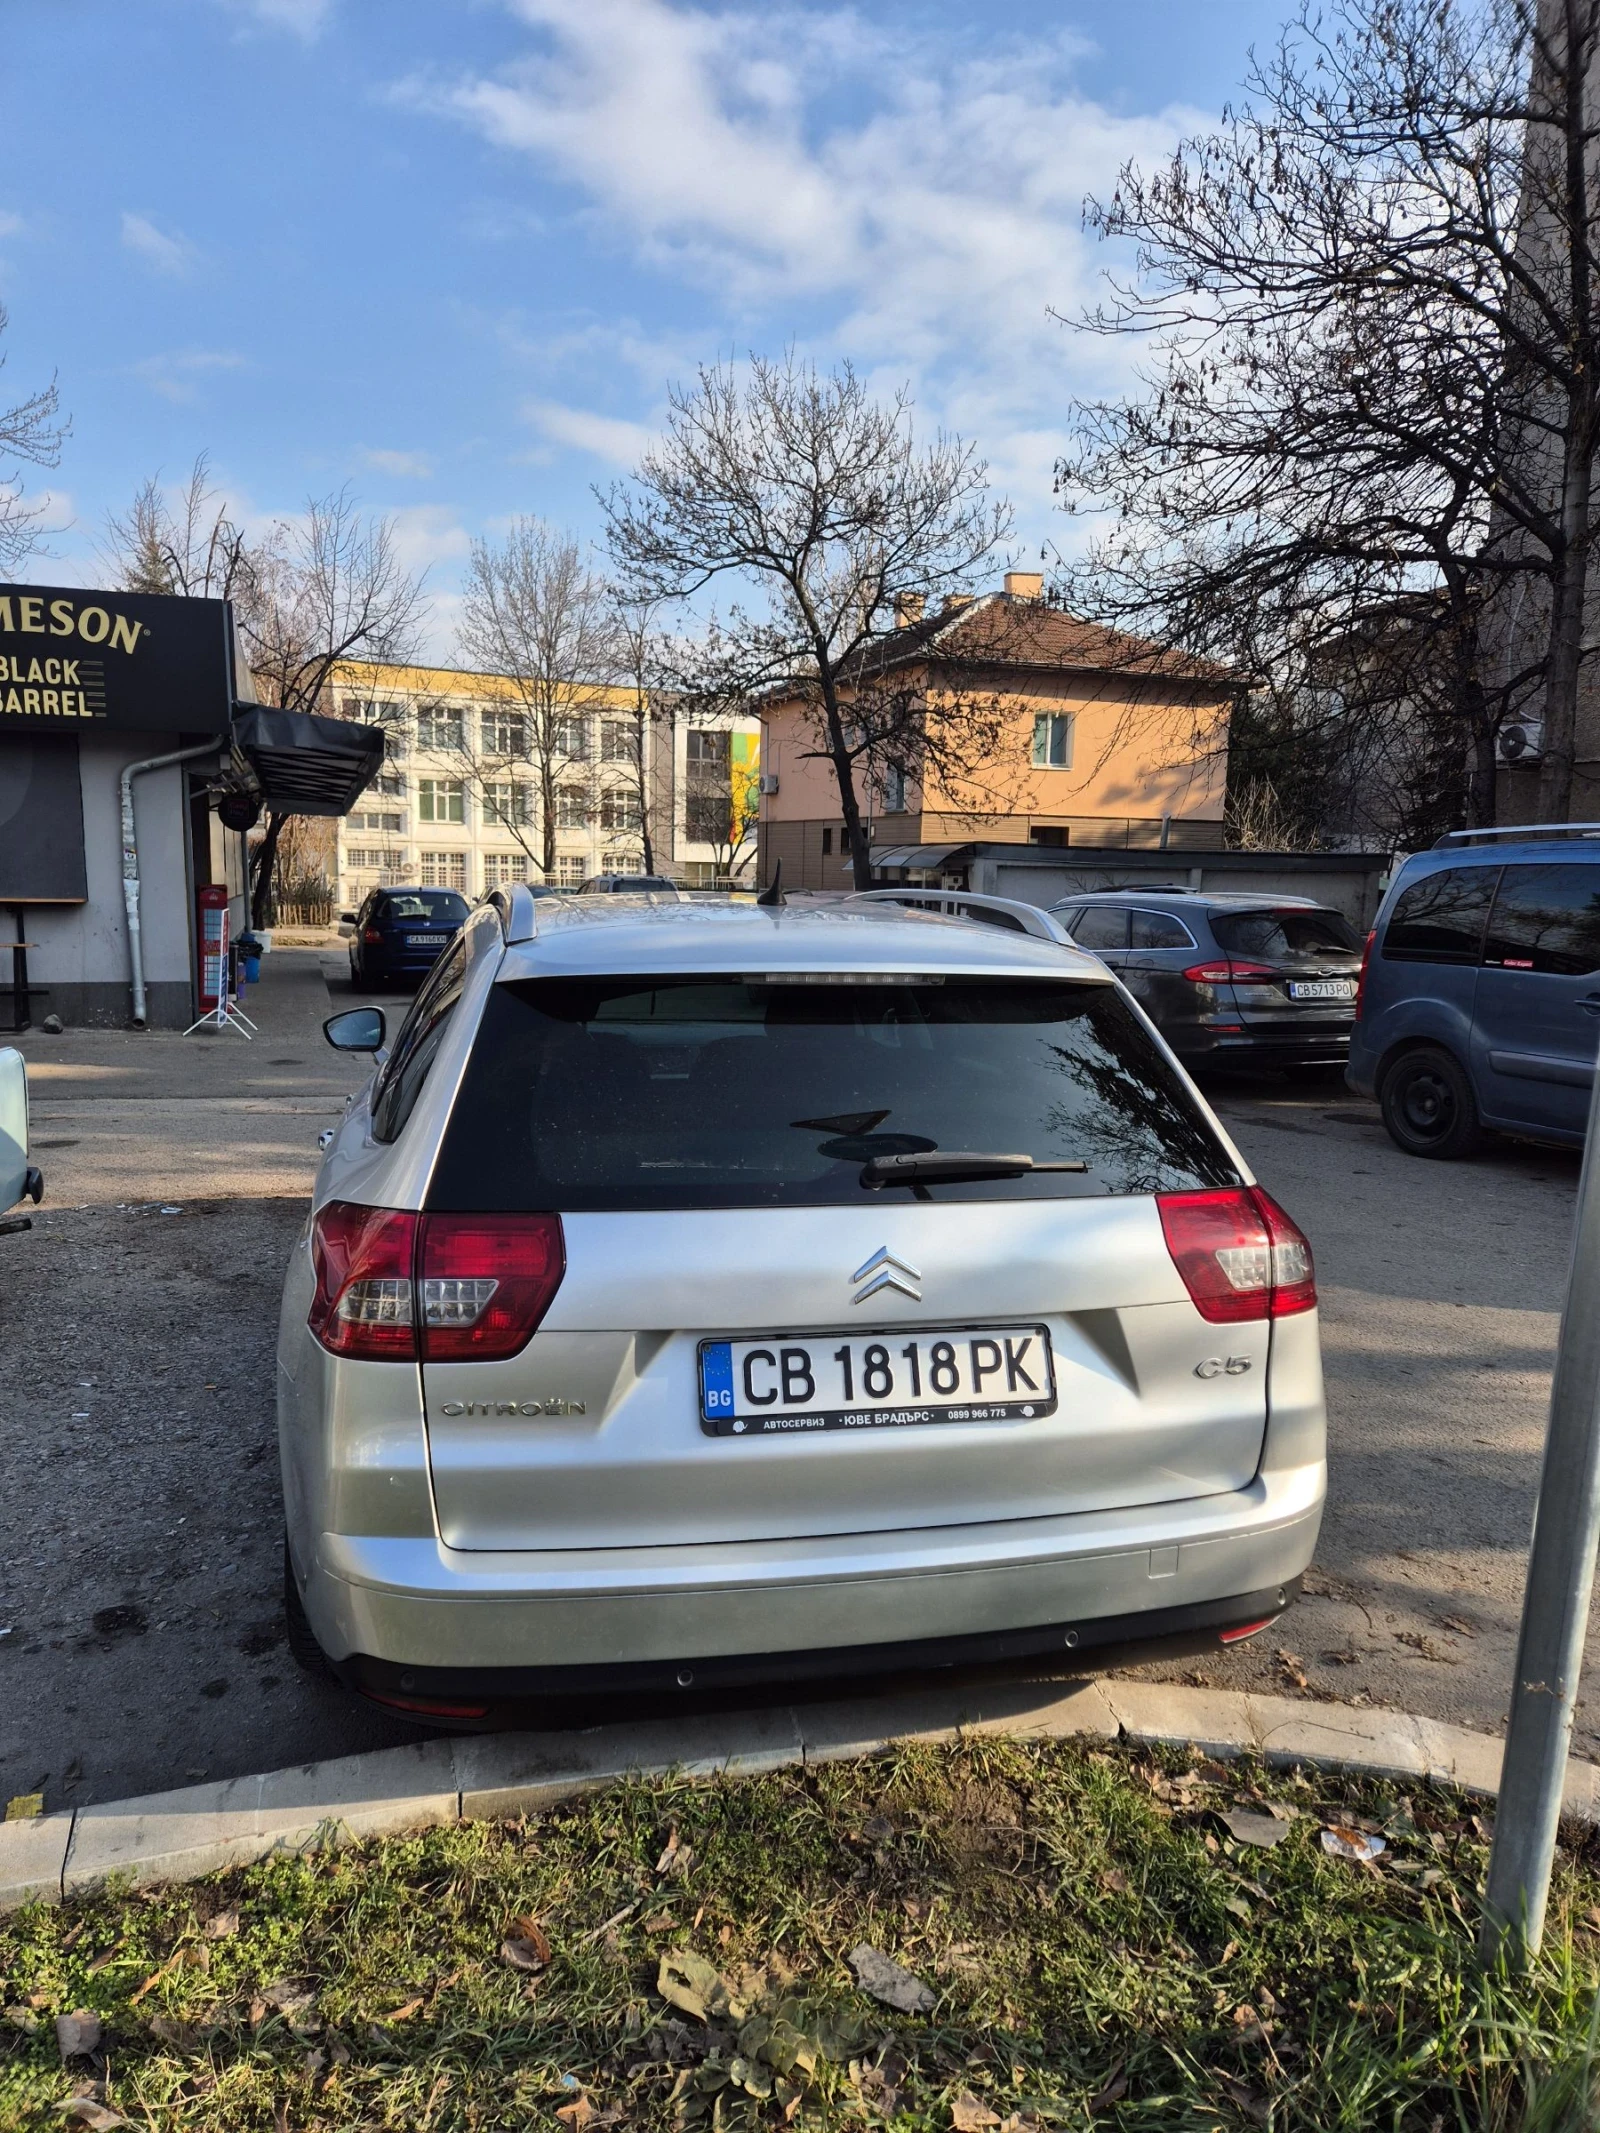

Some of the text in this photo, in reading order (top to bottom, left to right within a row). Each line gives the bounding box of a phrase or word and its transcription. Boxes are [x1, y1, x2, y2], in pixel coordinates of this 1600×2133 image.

[0, 687, 93, 717] ARREL
[1193, 1354, 1252, 1379] C5
[441, 1398, 587, 1417] CITROËN
[707, 1389, 731, 1408] BG
[763, 1417, 825, 1430] АВТОСЕРВИЗ
[947, 1410, 970, 1420] 0899
[971, 1409, 988, 1419] 966
[990, 1407, 1007, 1418] 775
